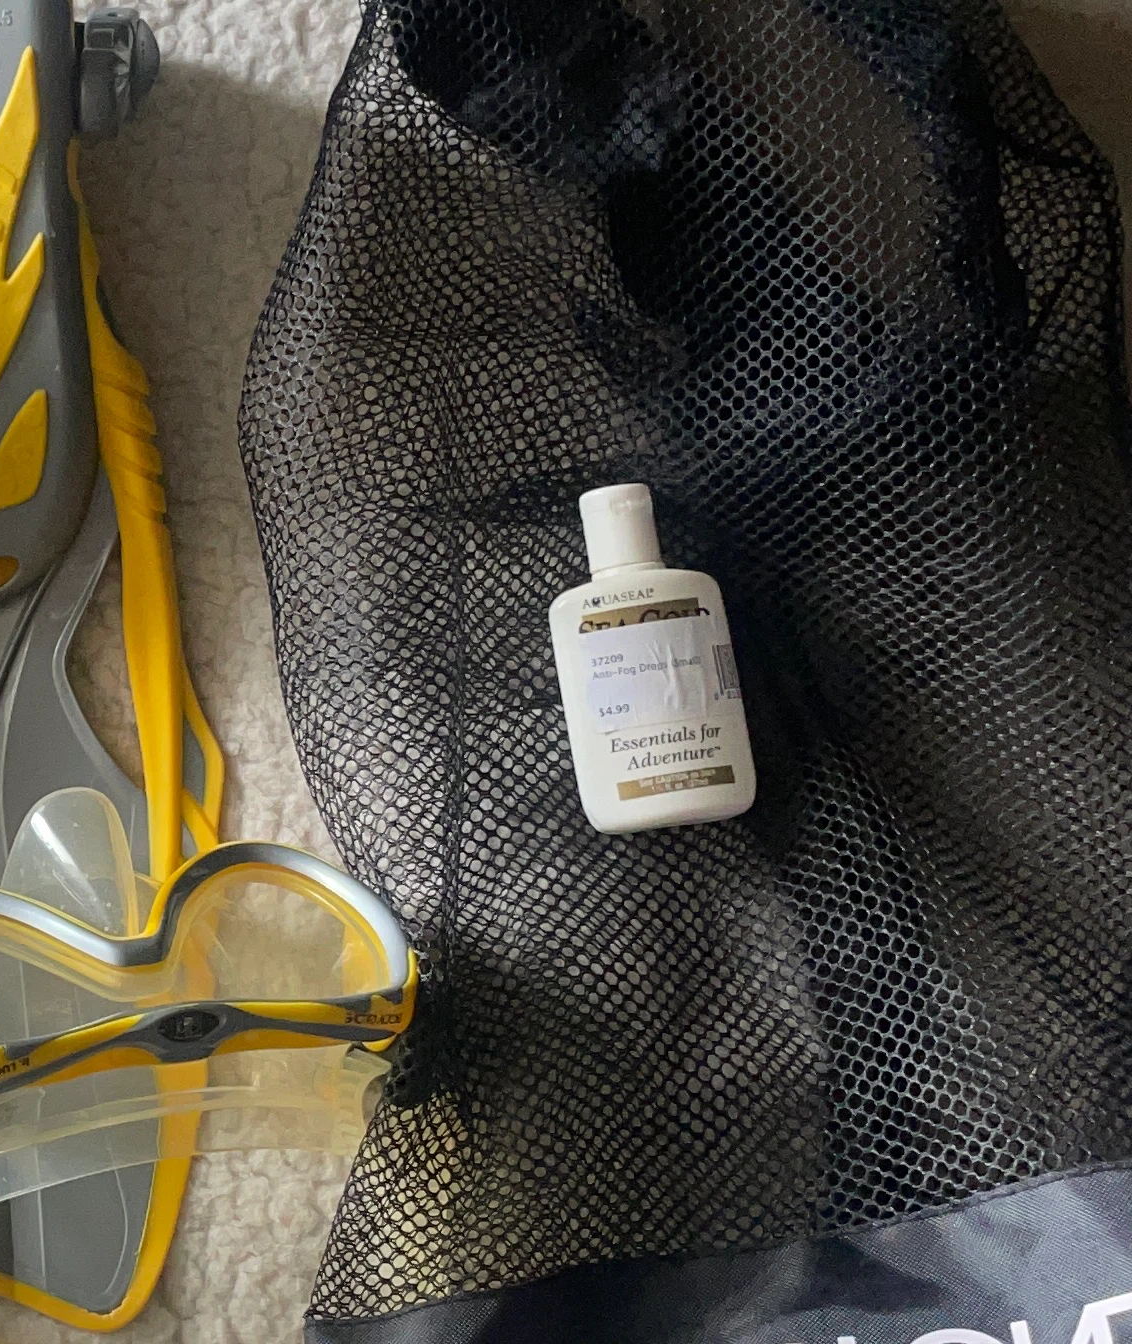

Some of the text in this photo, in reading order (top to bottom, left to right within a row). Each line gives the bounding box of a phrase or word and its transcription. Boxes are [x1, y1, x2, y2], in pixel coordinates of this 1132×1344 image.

[599, 703, 630, 717] $4.99
[610, 723, 721, 753] Essentials for
